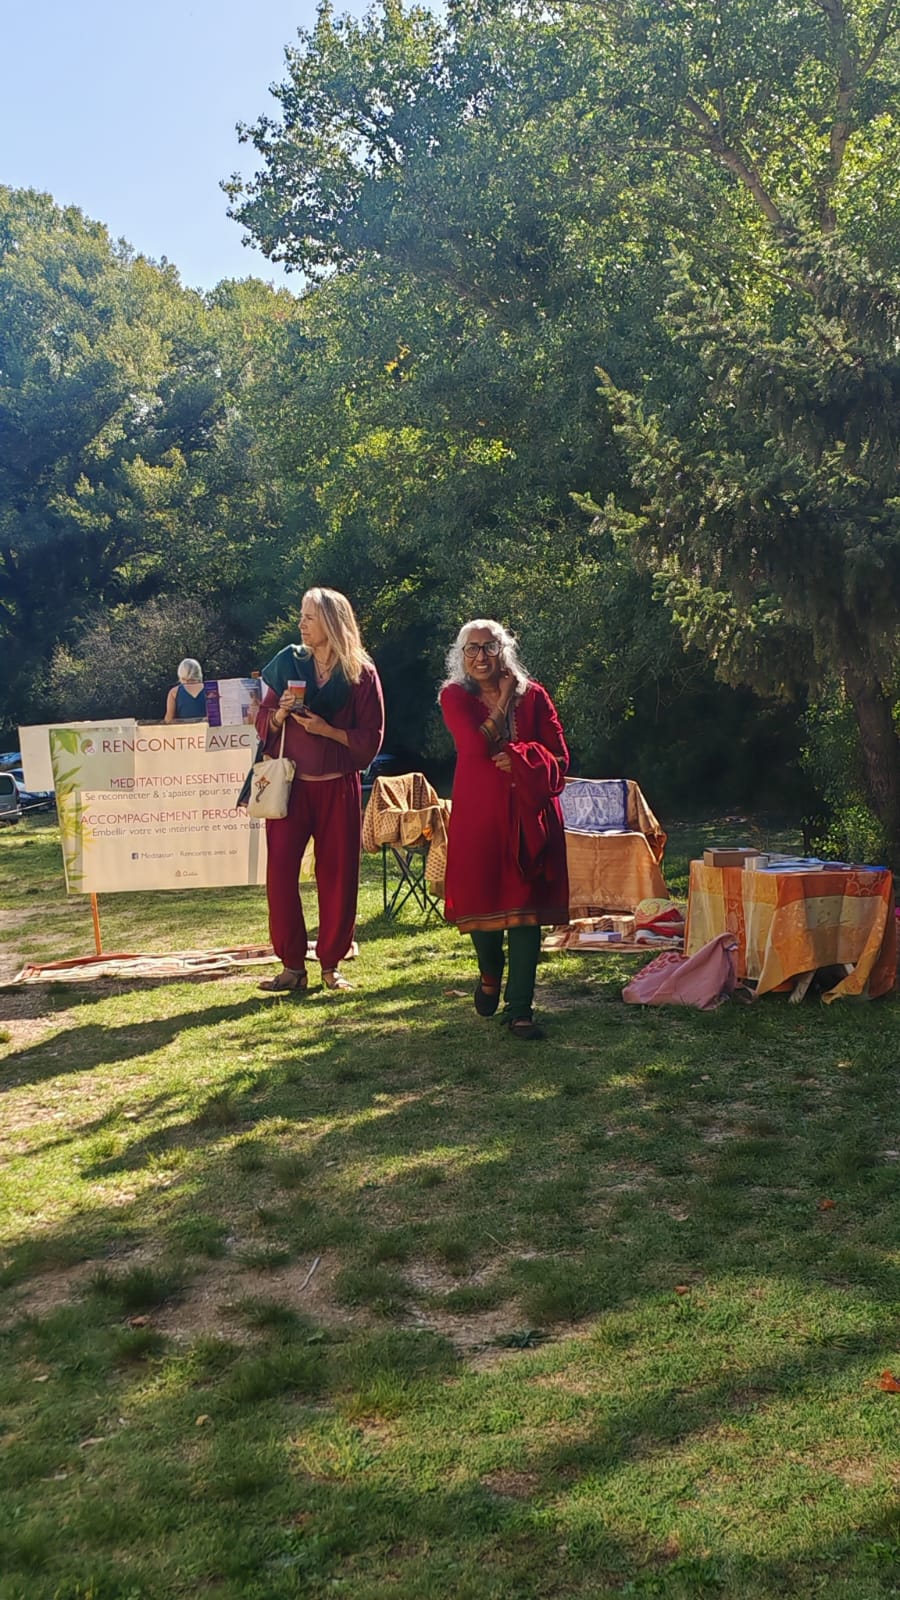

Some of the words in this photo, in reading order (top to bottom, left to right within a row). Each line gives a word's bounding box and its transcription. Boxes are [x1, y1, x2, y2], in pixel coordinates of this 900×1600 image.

[102, 736, 205, 753] RENCONTRE
[208, 733, 250, 748] AVEC
[110, 776, 182, 789] MEDITATION
[185, 773, 245, 785] ESSENTIELL
[85, 793, 96, 801] Se
[99, 791, 150, 801] reconnecter
[199, 789, 220, 799] pour
[222, 788, 232, 796] se
[81, 810, 198, 825] ACCOMPAGNEMENT
[202, 808, 248, 820] PERSON
[92, 827, 126, 837] Embellir
[129, 827, 152, 835] votre
[155, 826, 166, 834] vie
[212, 823, 222, 832] et
